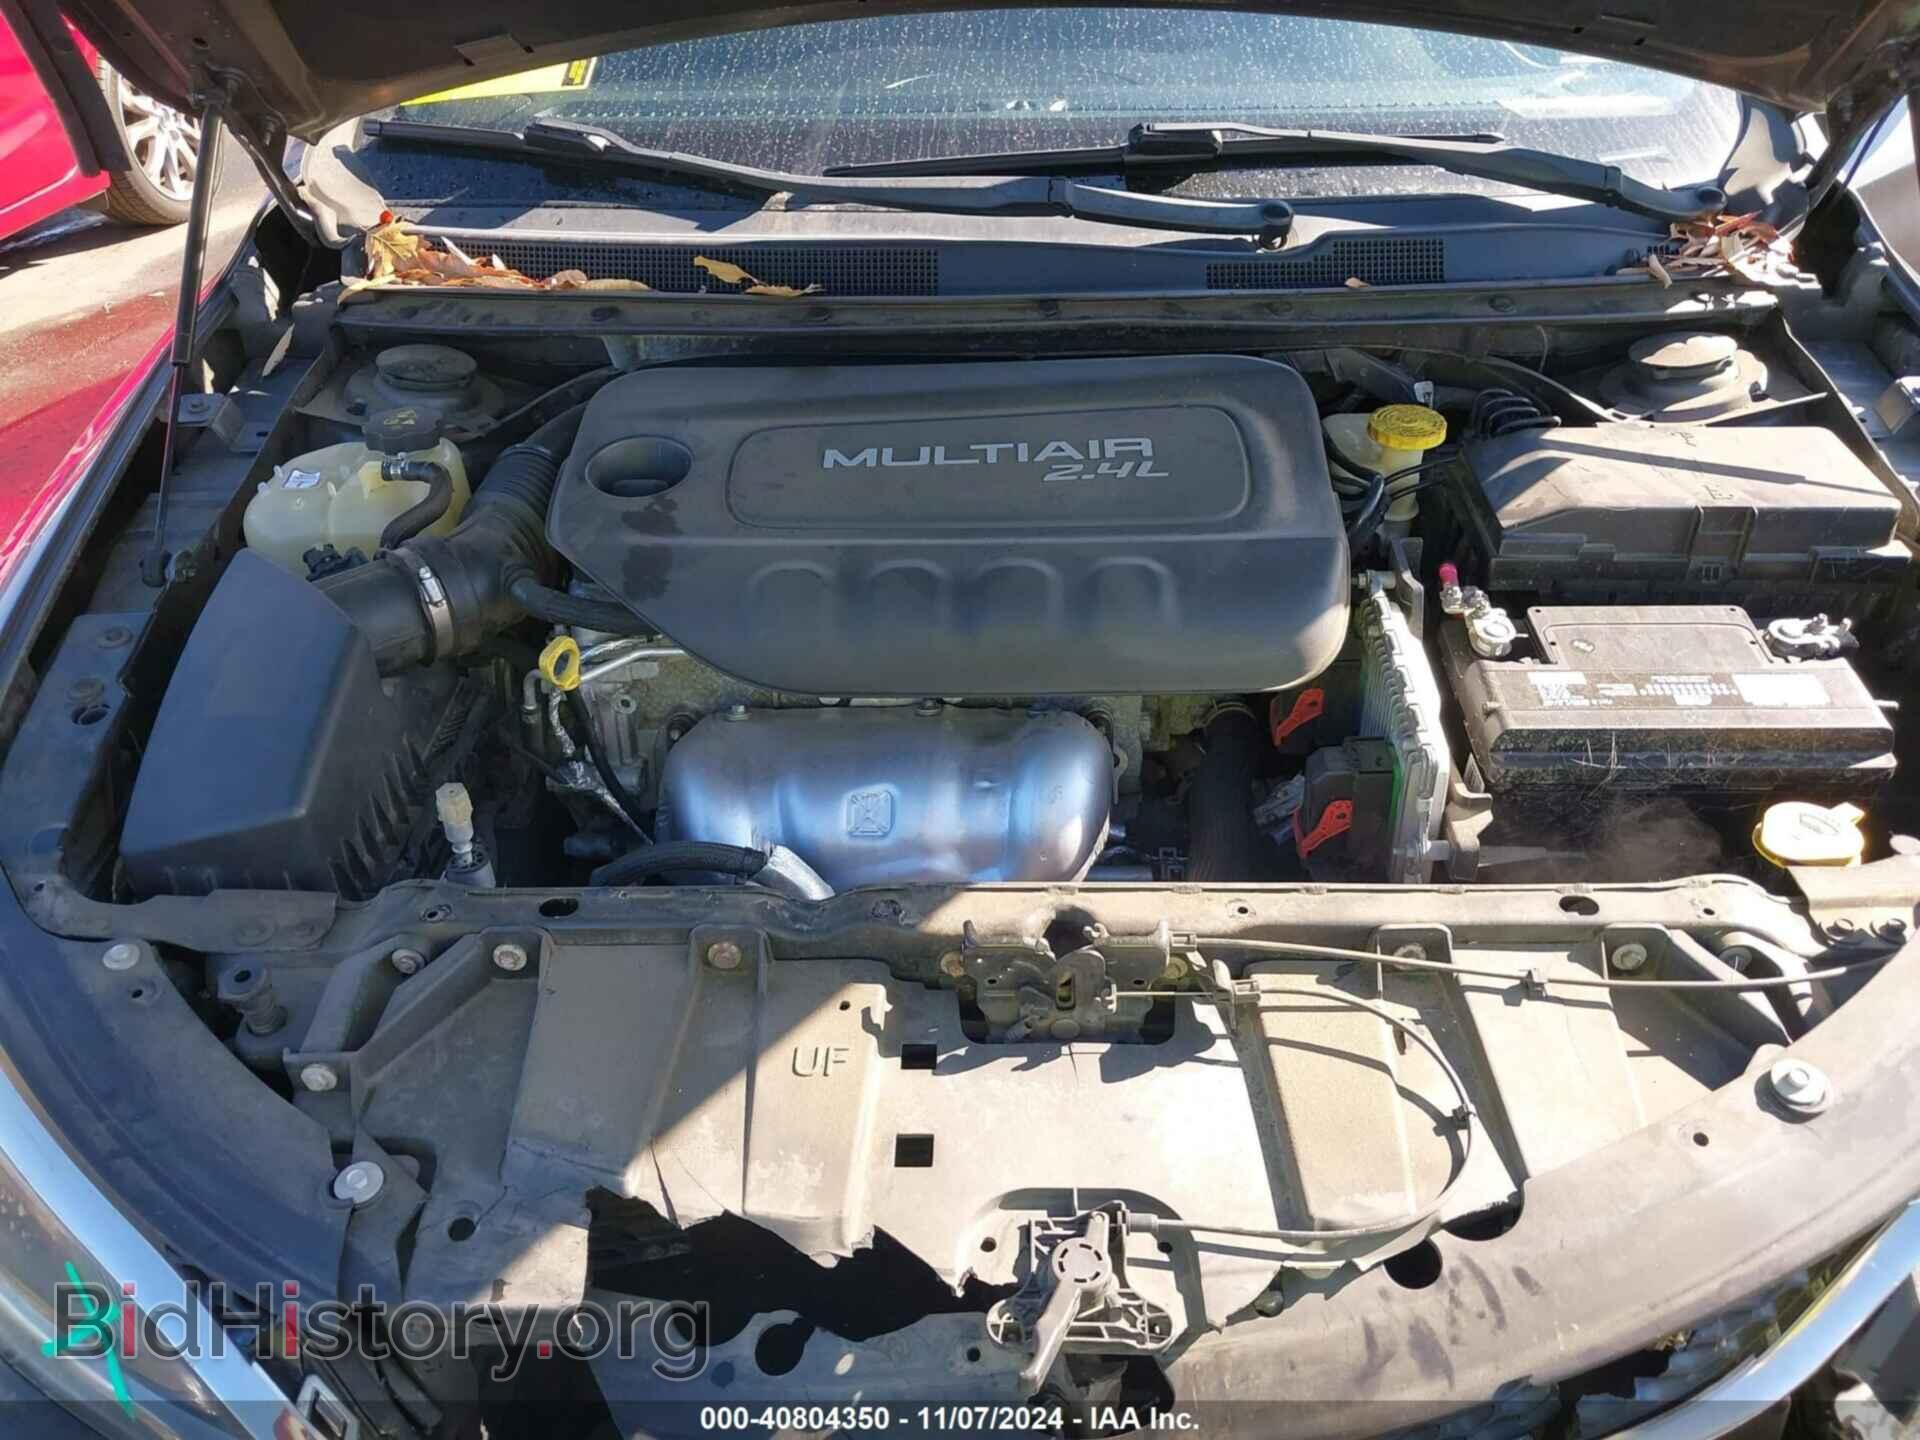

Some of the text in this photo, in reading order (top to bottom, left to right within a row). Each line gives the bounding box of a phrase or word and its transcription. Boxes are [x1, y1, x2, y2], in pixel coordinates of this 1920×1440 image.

[822, 437, 1154, 469] MULTIAIR
[1043, 460, 1169, 482] 2.4L
[791, 1046, 851, 1078] UF
